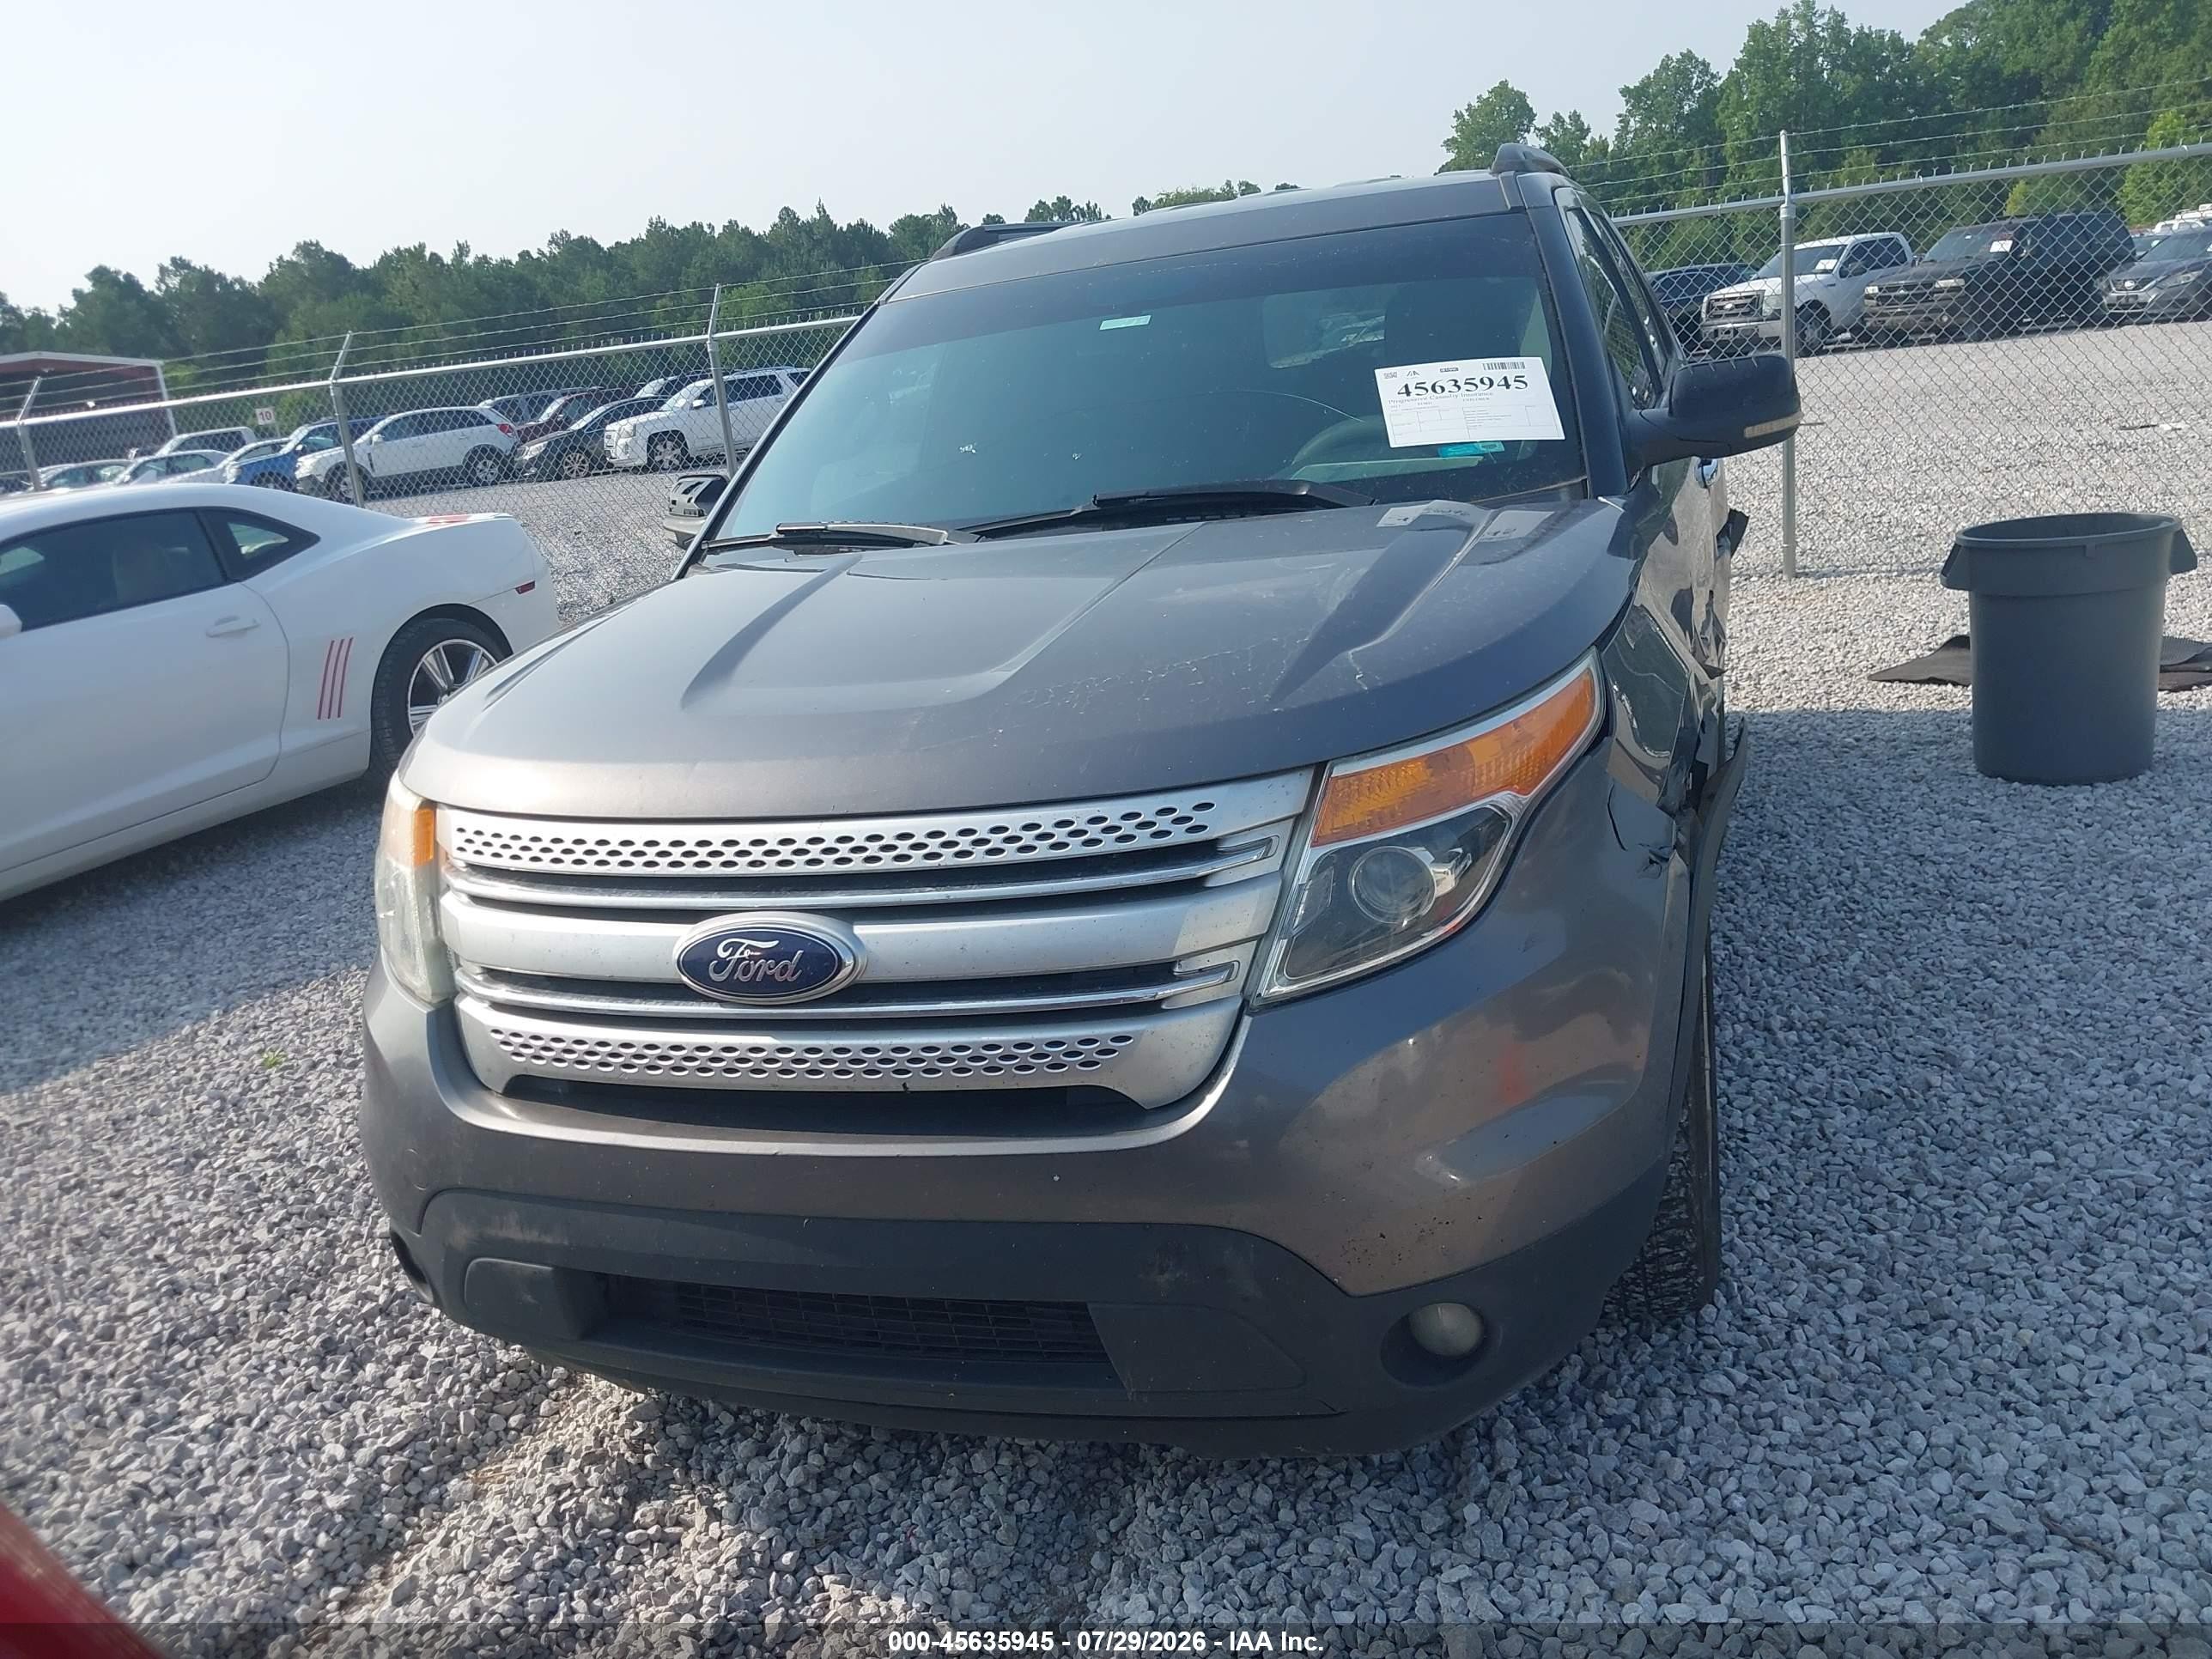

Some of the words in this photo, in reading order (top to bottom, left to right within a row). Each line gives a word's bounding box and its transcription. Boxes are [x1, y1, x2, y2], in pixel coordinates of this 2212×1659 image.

[1397, 375, 1528, 397] 45635945
[258, 410, 272, 421] 10
[708, 938, 804, 982] Ford
